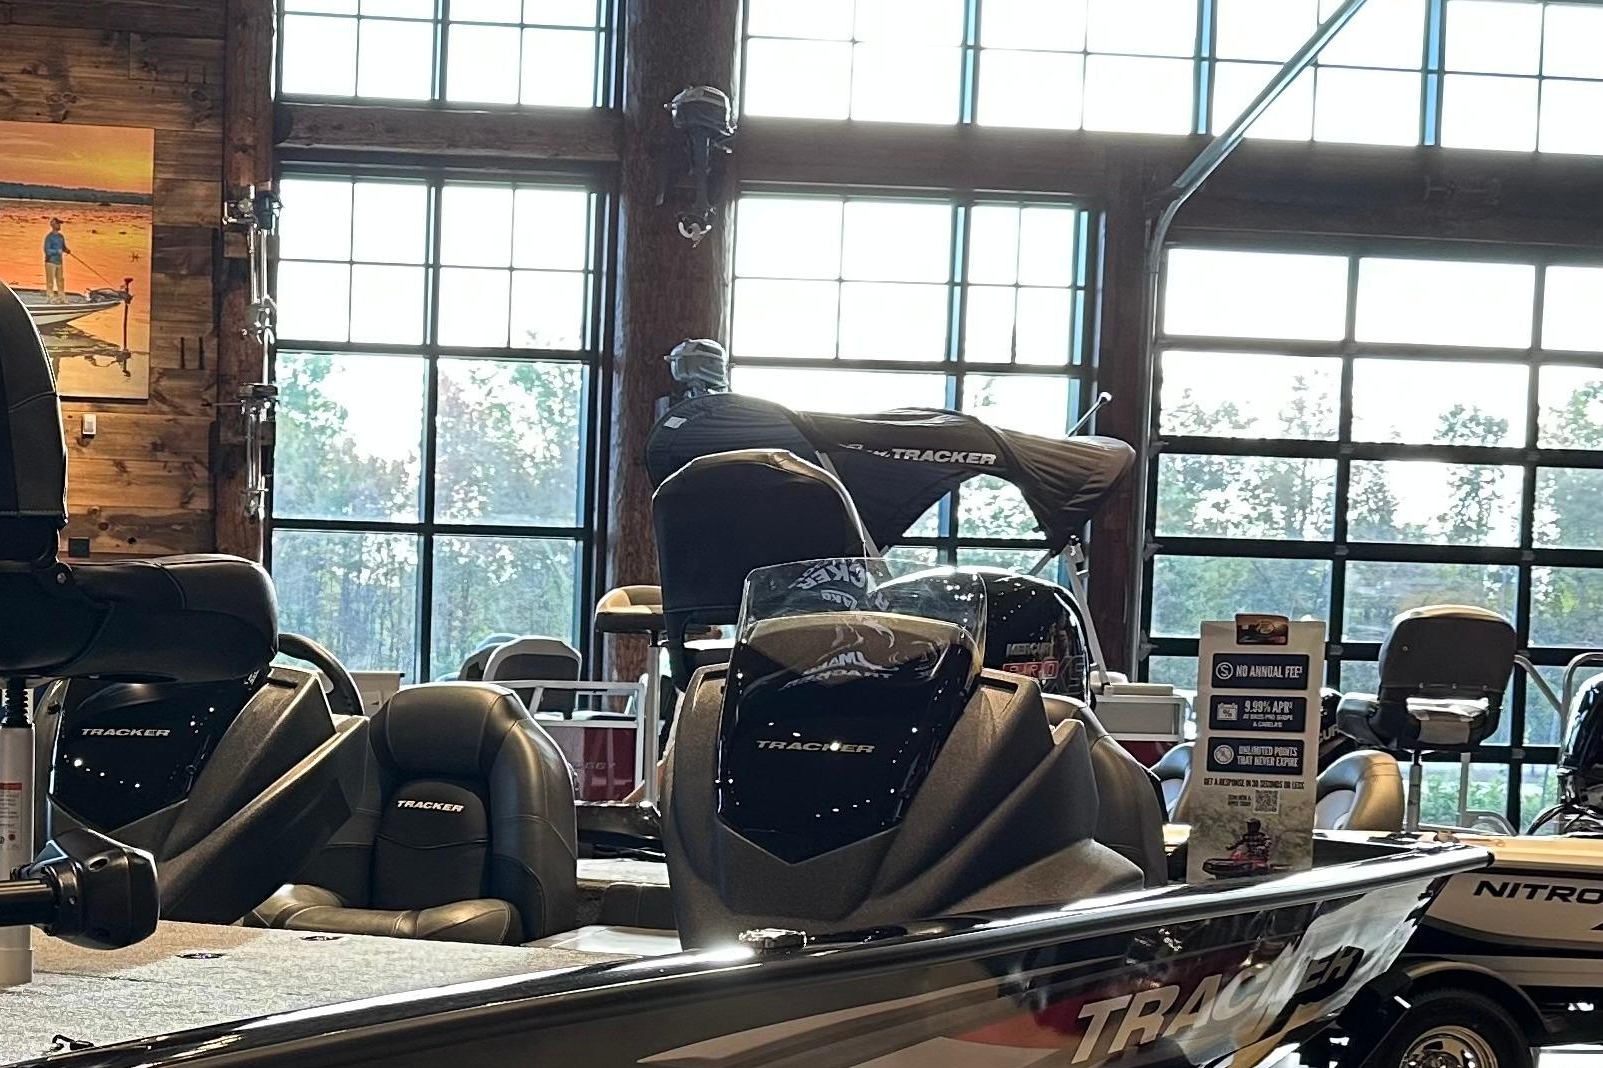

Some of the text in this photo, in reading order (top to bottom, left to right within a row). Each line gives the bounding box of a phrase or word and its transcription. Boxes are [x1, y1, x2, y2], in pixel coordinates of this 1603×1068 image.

[890, 448, 997, 466] TRACKER
[1236, 665, 1248, 677] NO
[1249, 665, 1283, 678] ANNUAL
[81, 728, 171, 737] TRACKER
[397, 799, 464, 813] TRACKER
[1472, 880, 1603, 905] NITRO
